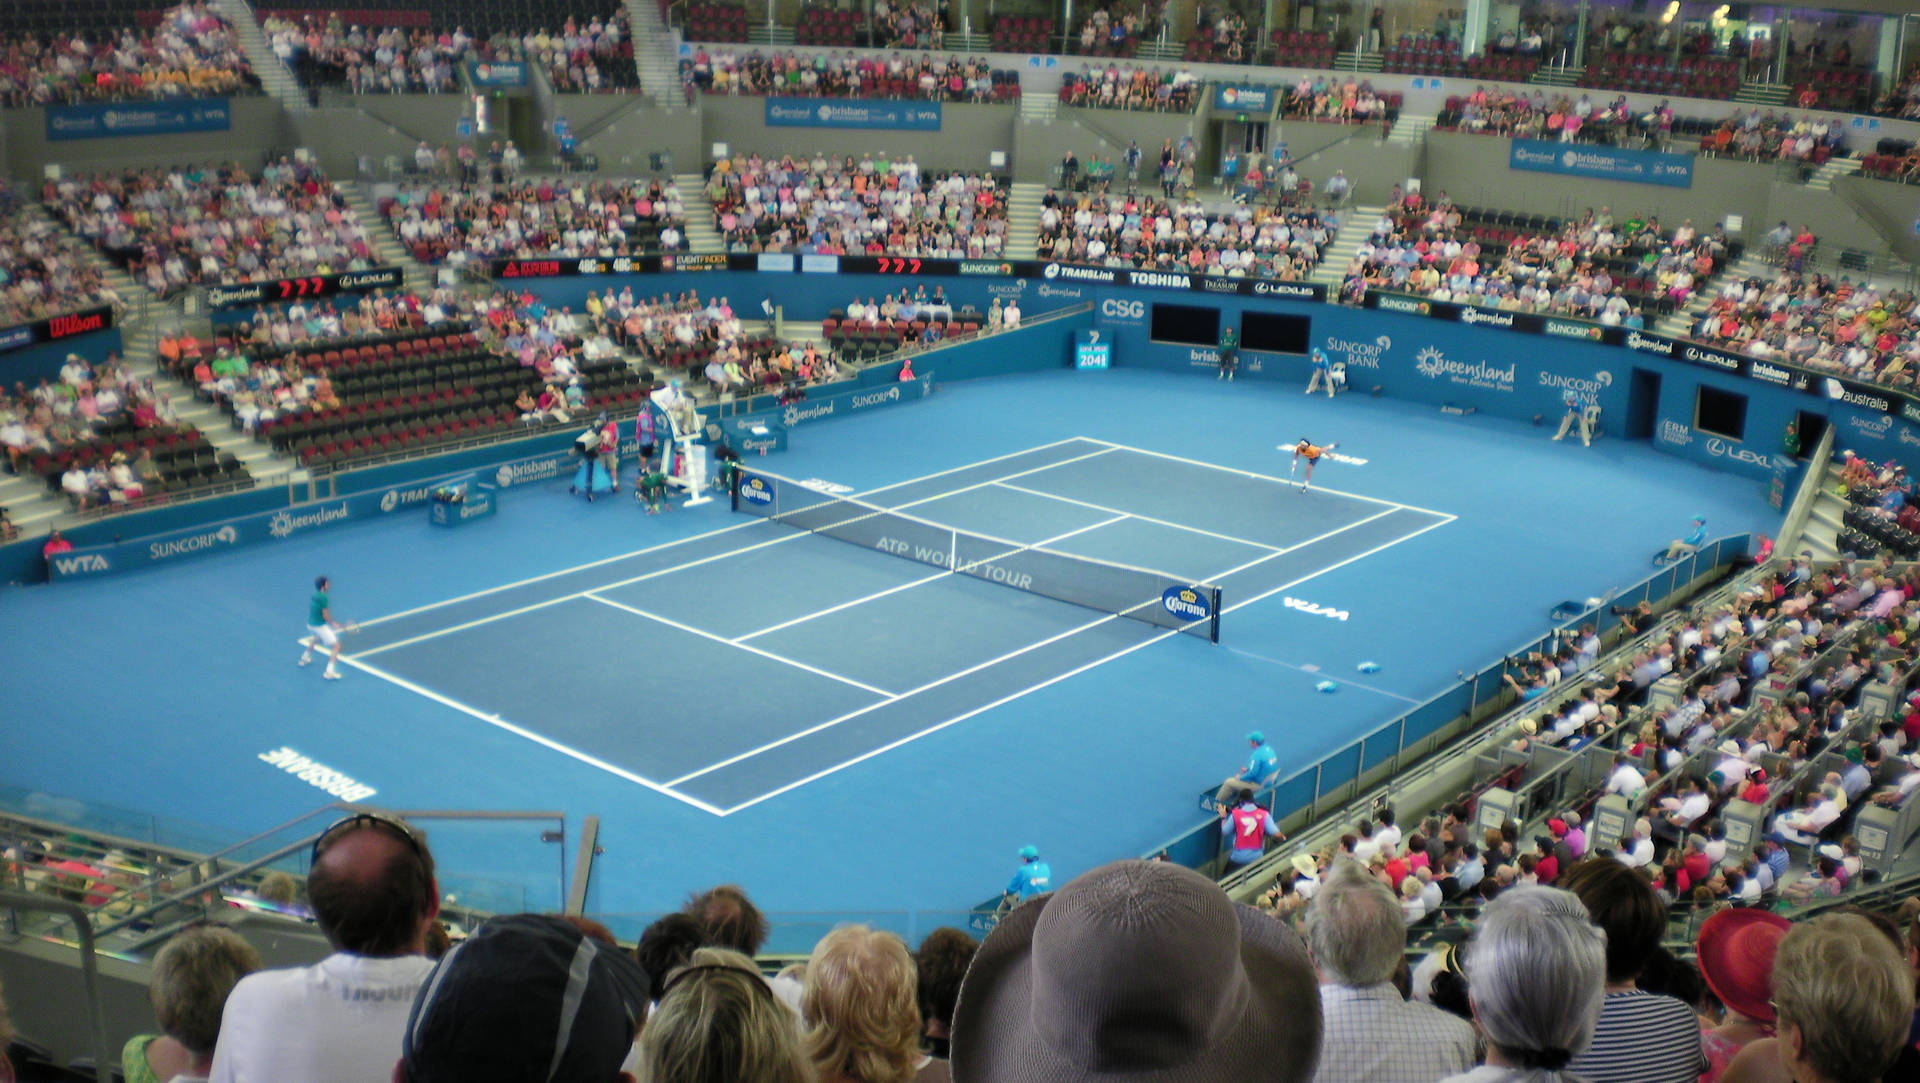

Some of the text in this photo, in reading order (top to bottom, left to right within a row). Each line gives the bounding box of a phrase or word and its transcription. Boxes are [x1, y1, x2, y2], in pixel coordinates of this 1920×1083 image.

[353, 273, 394, 285] LEXUS
[1061, 266, 1115, 281] TRANSLink
[1129, 271, 1191, 288] TOSHIBA
[1270, 285, 1314, 296] LEXUS
[1102, 299, 1145, 318] CSG
[1380, 297, 1419, 312] SUNCORP
[1462, 305, 1513, 326] Queensland
[49, 313, 103, 339] Wilson
[1548, 322, 1590, 337] SUNCORP
[1328, 337, 1382, 357] SUNCORP
[1628, 332, 1673, 354] Queensland
[1347, 354, 1380, 369] BANK
[1415, 345, 1516, 383] Queensland
[1698, 351, 1739, 369] LEXUS
[1753, 361, 1790, 381] brisbane
[1539, 371, 1602, 393] SUNCORP
[851, 391, 890, 409] SUNCORP
[1843, 391, 1888, 411] australia
[783, 400, 834, 427] Queensland
[513, 458, 557, 476] brisbane
[741, 484, 771, 502] Corona
[269, 501, 348, 538] Queensland
[150, 533, 217, 560] SUNCORP
[56, 555, 110, 575] WTA
[876, 536, 910, 554] ATP
[984, 564, 1032, 590] TOUR
[1165, 595, 1206, 617] Corona
